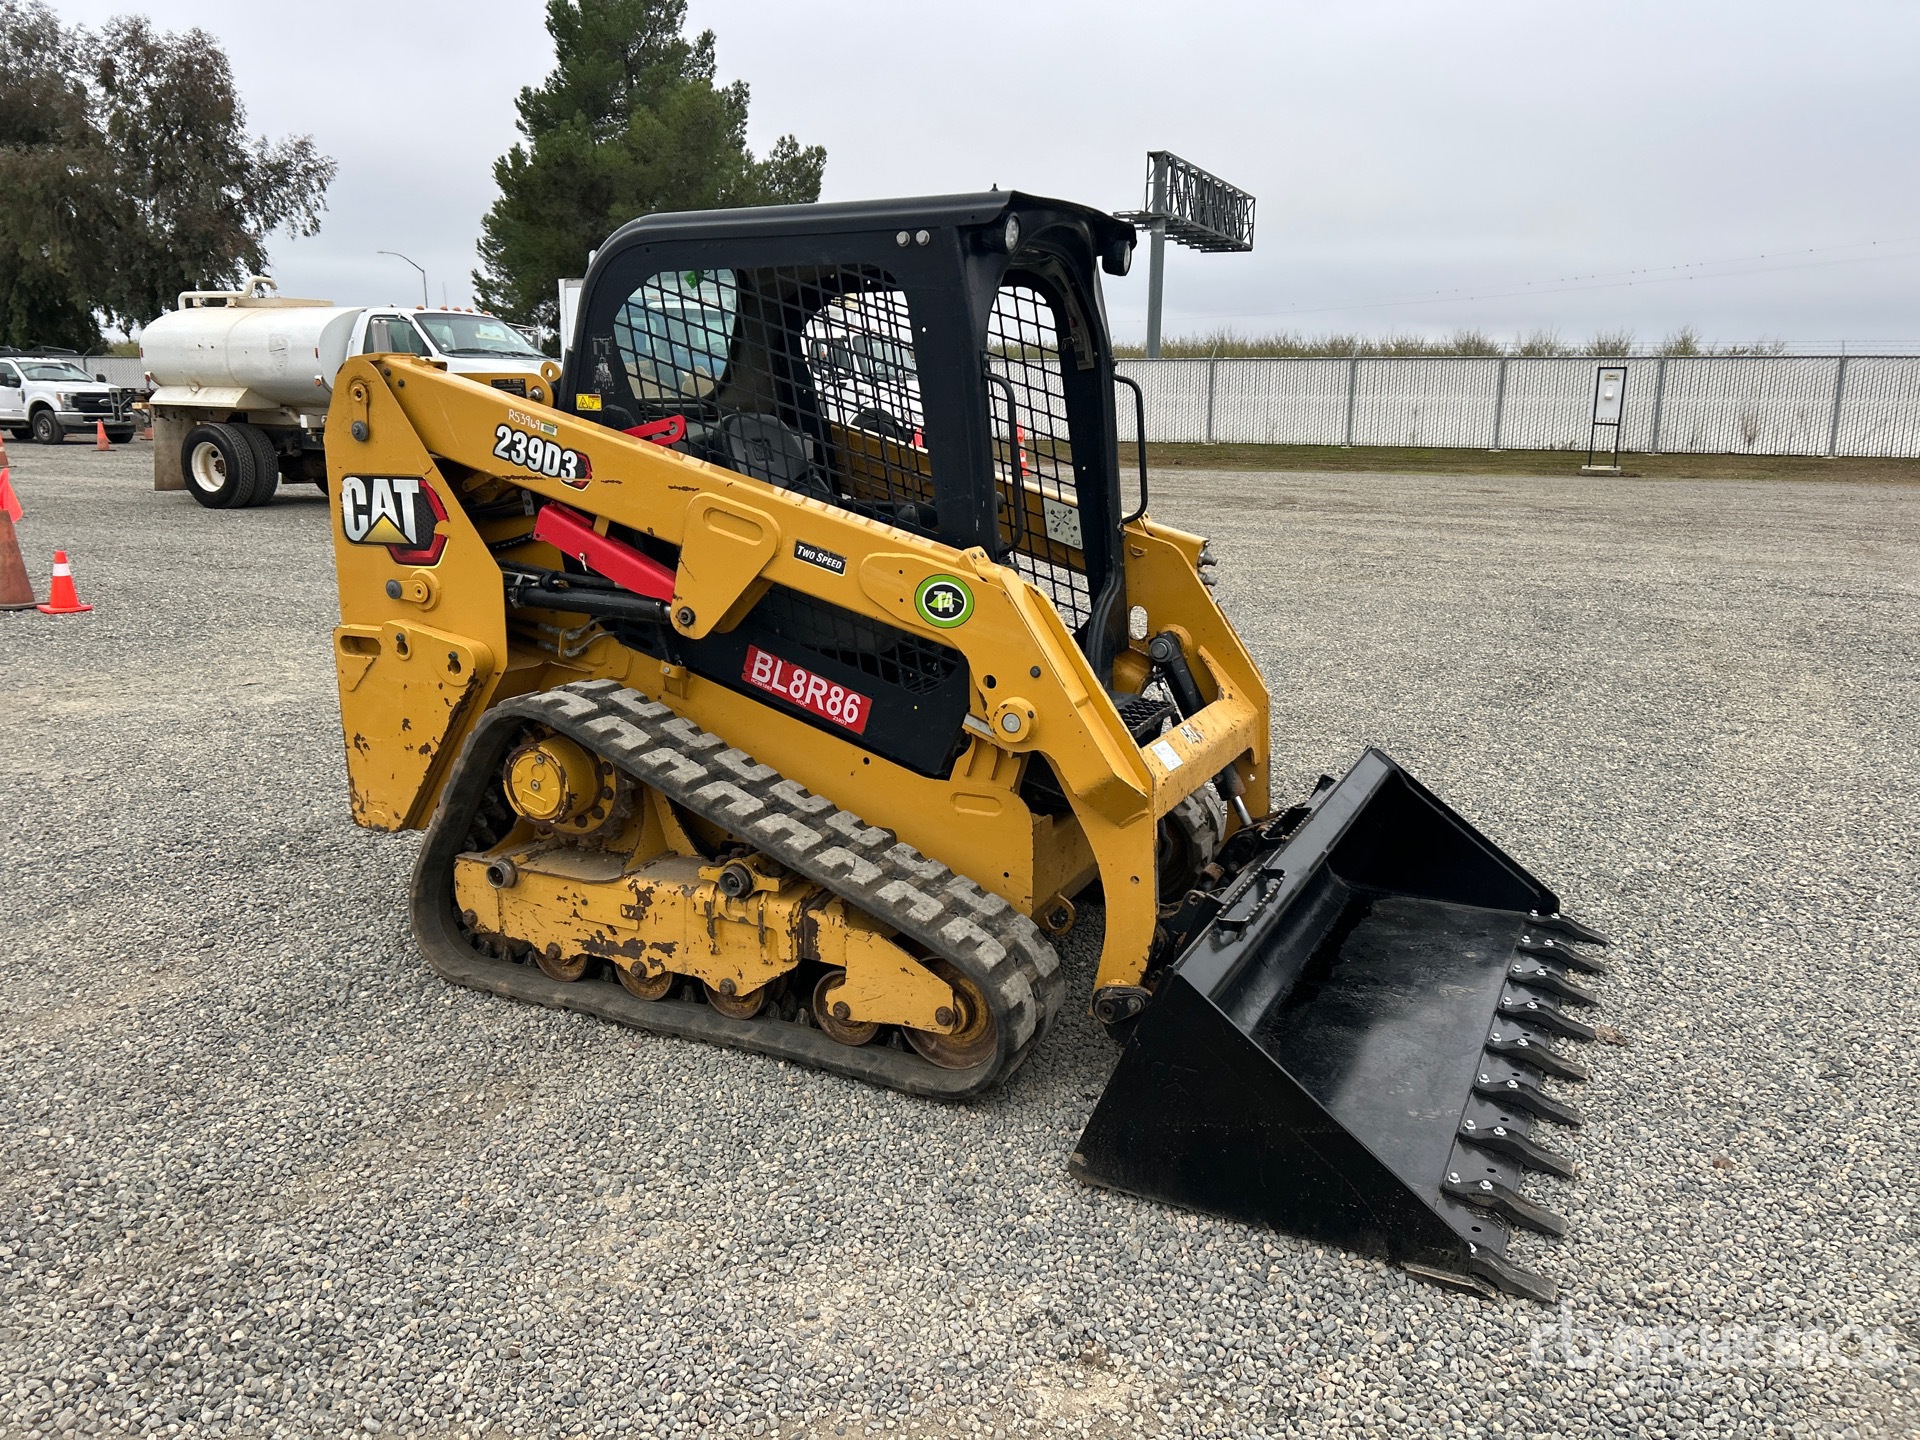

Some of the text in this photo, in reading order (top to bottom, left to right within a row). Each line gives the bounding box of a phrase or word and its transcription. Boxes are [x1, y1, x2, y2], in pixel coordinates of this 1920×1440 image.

[508, 409, 541, 431] R53969
[494, 425, 578, 483] 239D3
[341, 477, 419, 544] CAT
[751, 650, 861, 723] BL8R86
